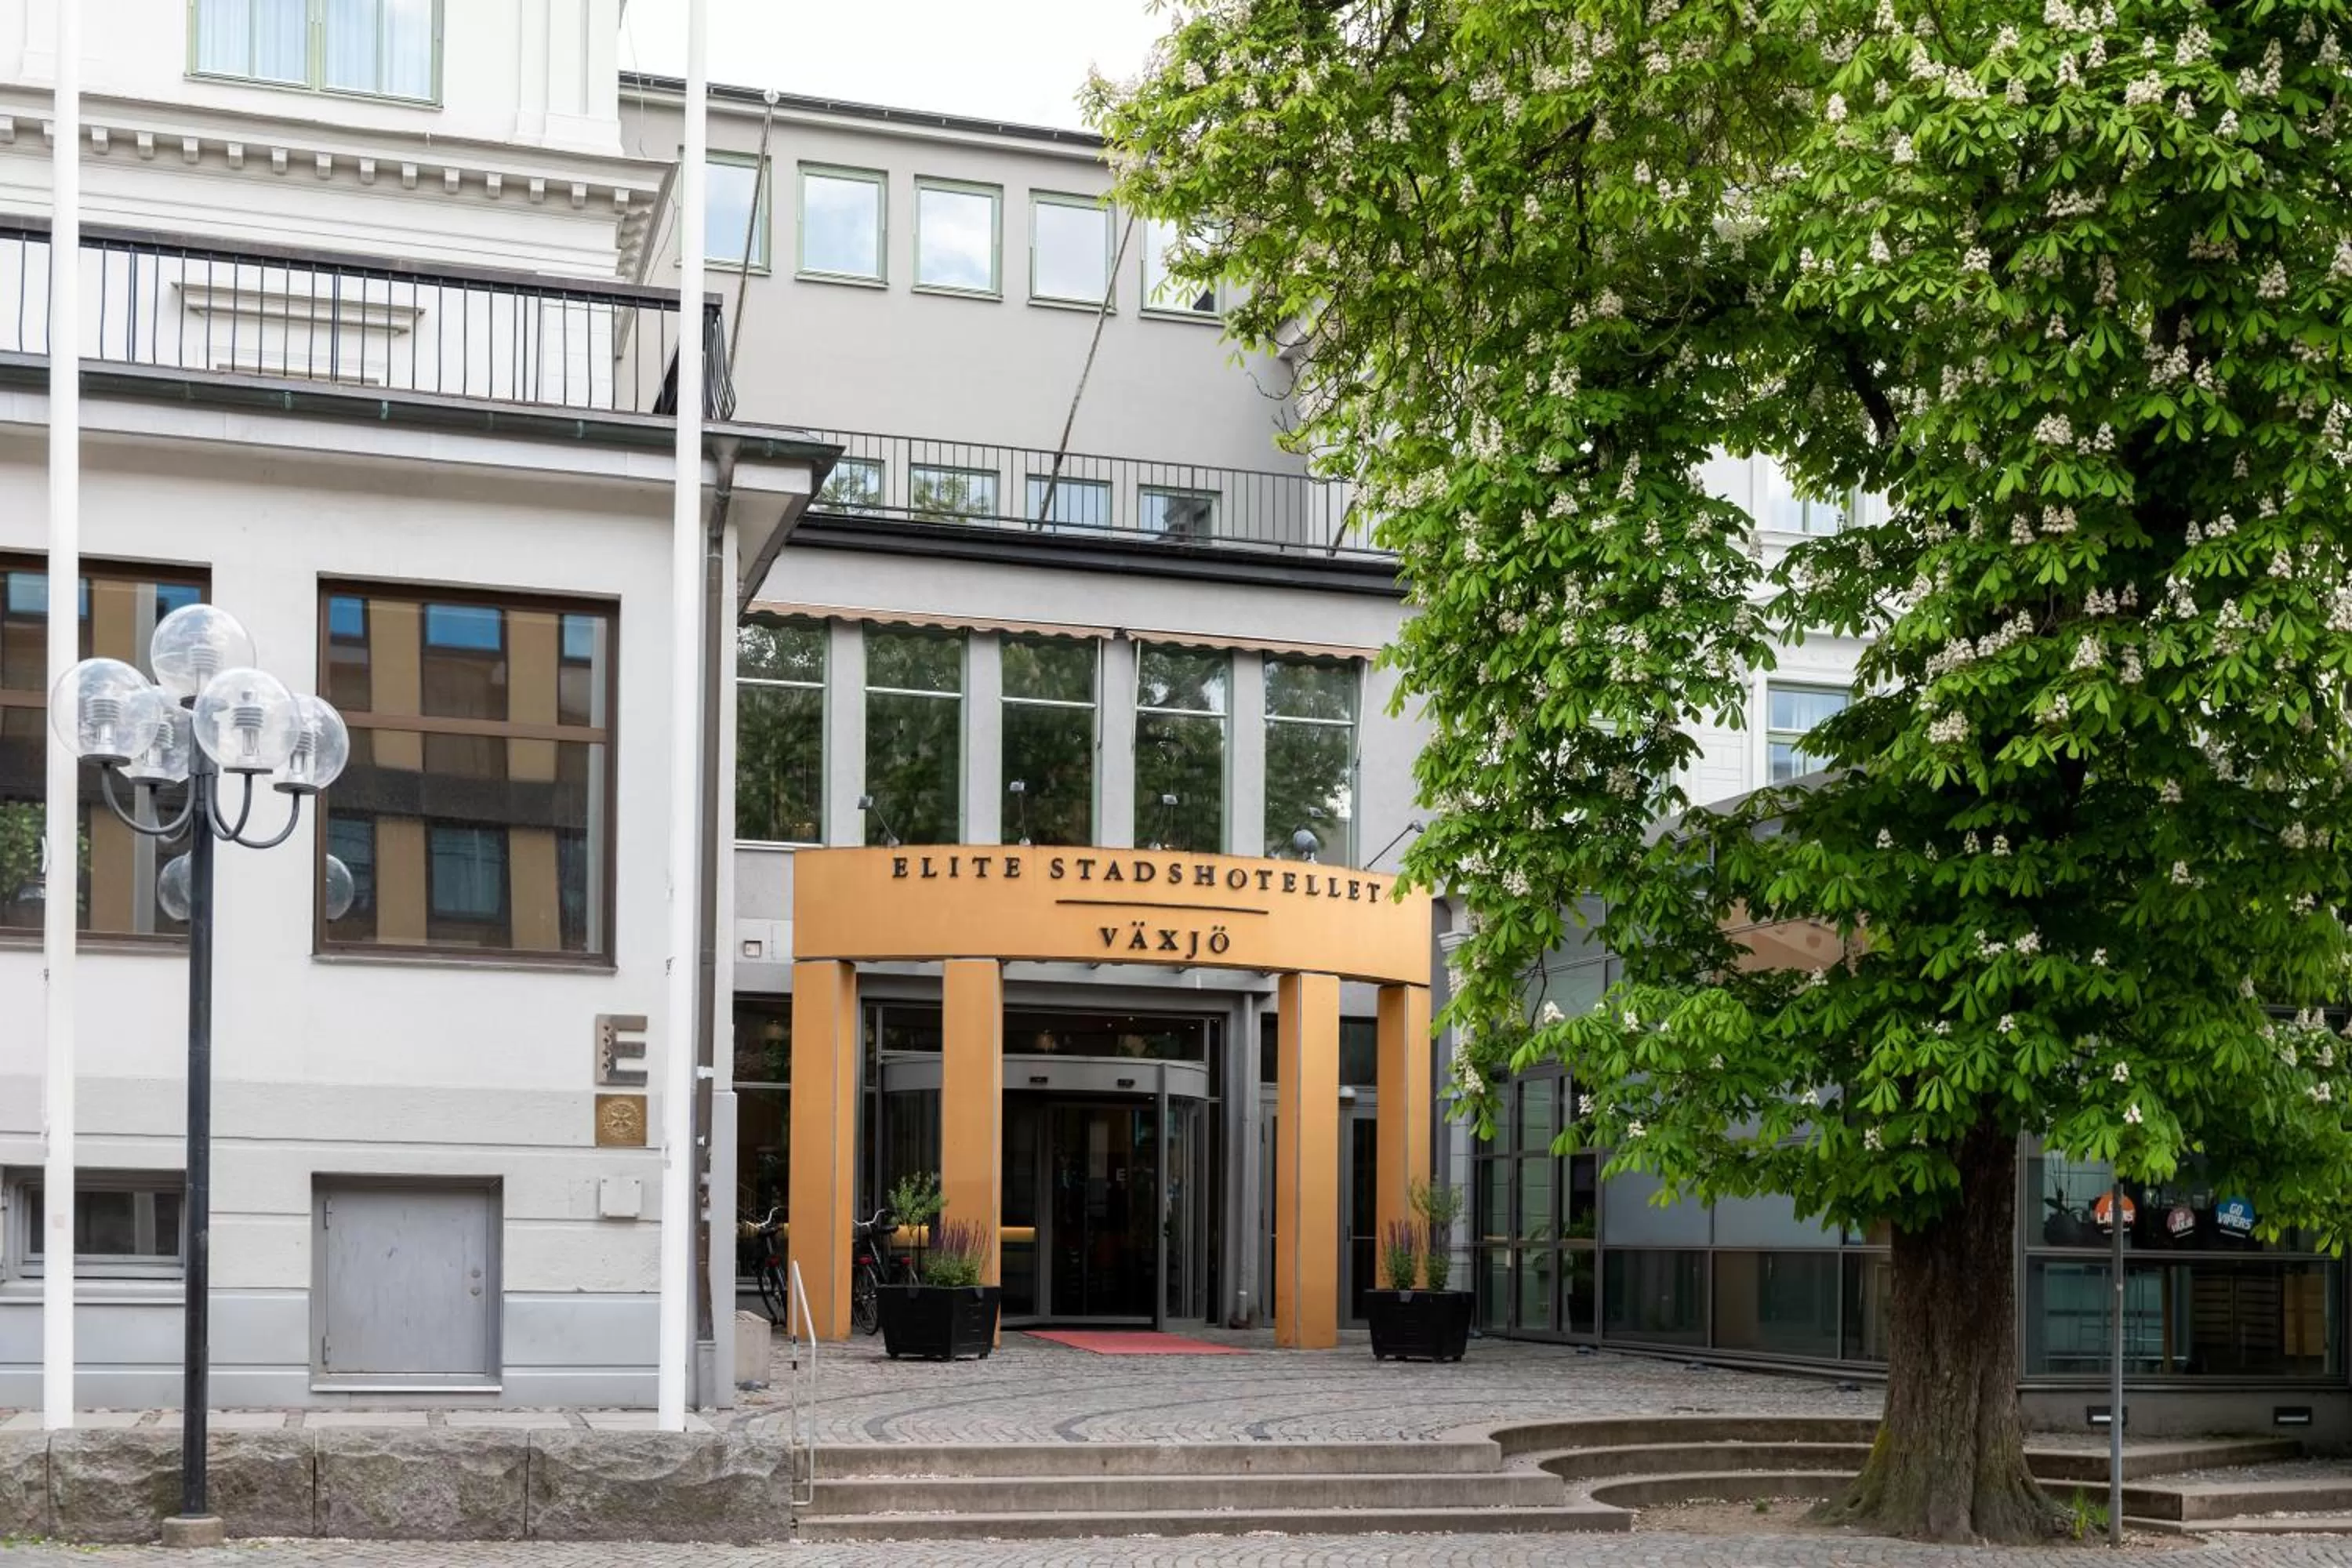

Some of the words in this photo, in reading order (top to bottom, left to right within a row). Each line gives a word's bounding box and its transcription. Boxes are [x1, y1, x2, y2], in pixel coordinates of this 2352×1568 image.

[892, 856, 1022, 879] ELITE
[1050, 858, 1381, 903] STADSHOTELLET
[1099, 920, 1230, 959] VÄXJÖ
[2217, 1211, 2252, 1230] VIPERS
[2229, 1203, 2244, 1216] GO
